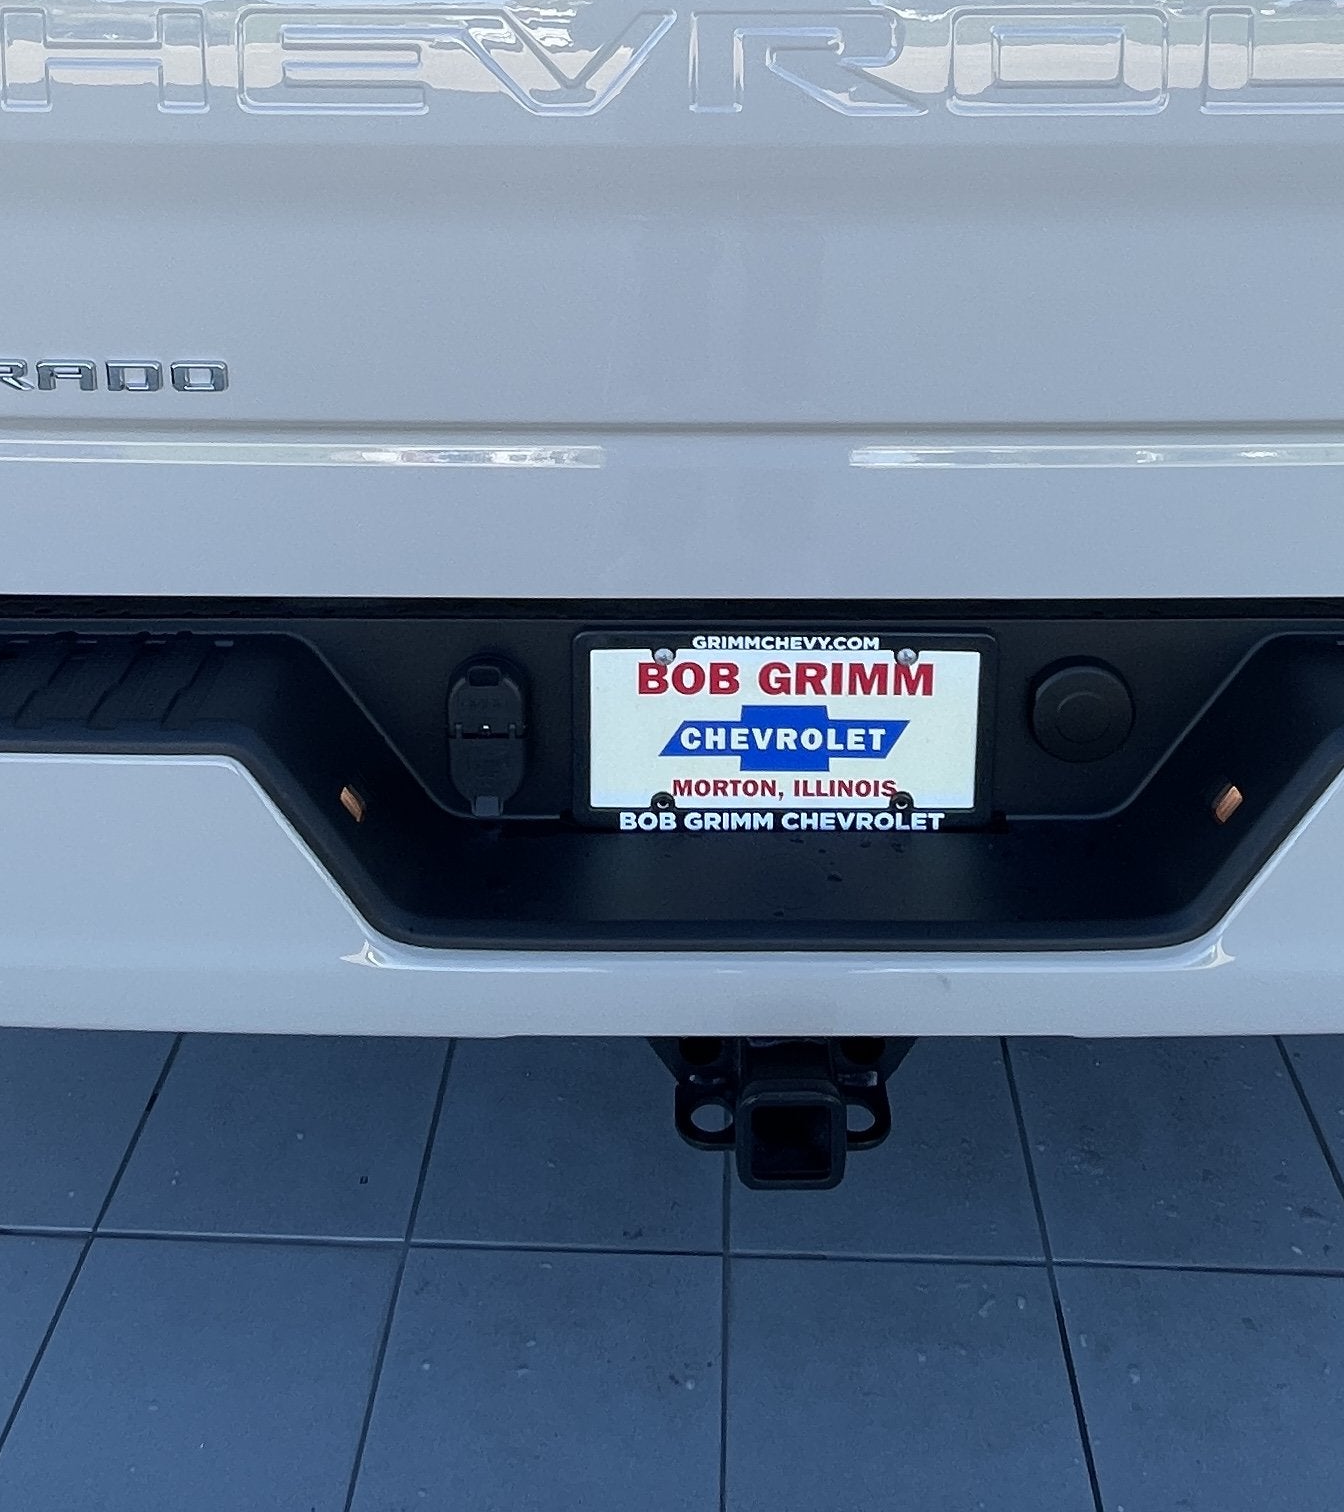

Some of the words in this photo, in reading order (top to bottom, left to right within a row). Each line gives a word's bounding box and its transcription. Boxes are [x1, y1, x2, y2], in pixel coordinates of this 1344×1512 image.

[692, 635, 880, 650] GRIMMCHEVY.COM
[638, 661, 740, 696] BOB
[758, 661, 934, 696] GRIMM
[679, 726, 887, 752] CHEVROLET
[672, 779, 784, 801] MORTON,
[794, 779, 898, 797] ILLINOIS
[619, 811, 677, 831] BOB
[683, 811, 774, 831] GRIMM
[781, 811, 945, 831] CHEVROLET
